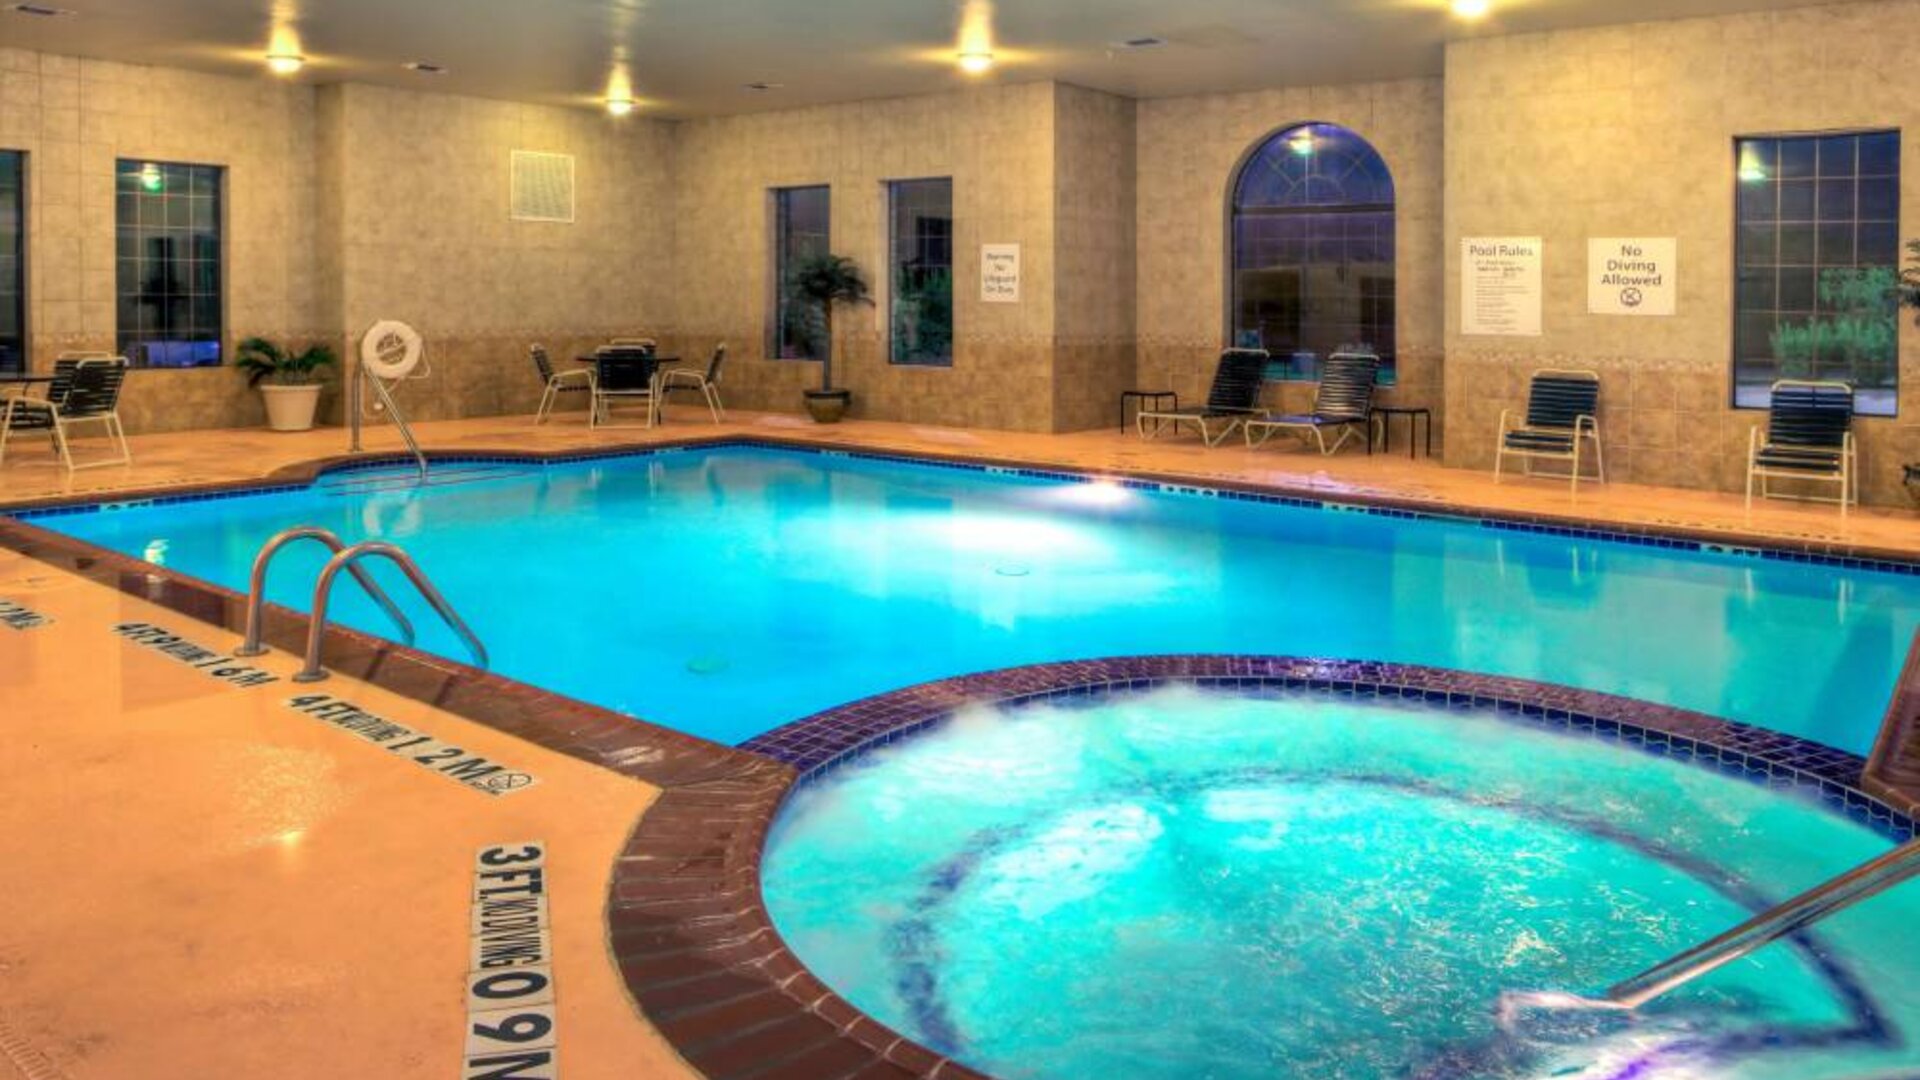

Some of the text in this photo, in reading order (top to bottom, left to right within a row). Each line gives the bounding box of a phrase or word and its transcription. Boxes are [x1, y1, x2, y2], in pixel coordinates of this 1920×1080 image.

[1470, 245, 1533, 256] Pool Rules
[1621, 245, 1642, 256] No
[1607, 260, 1656, 273] Diving
[1601, 274, 1662, 286] Allowed
